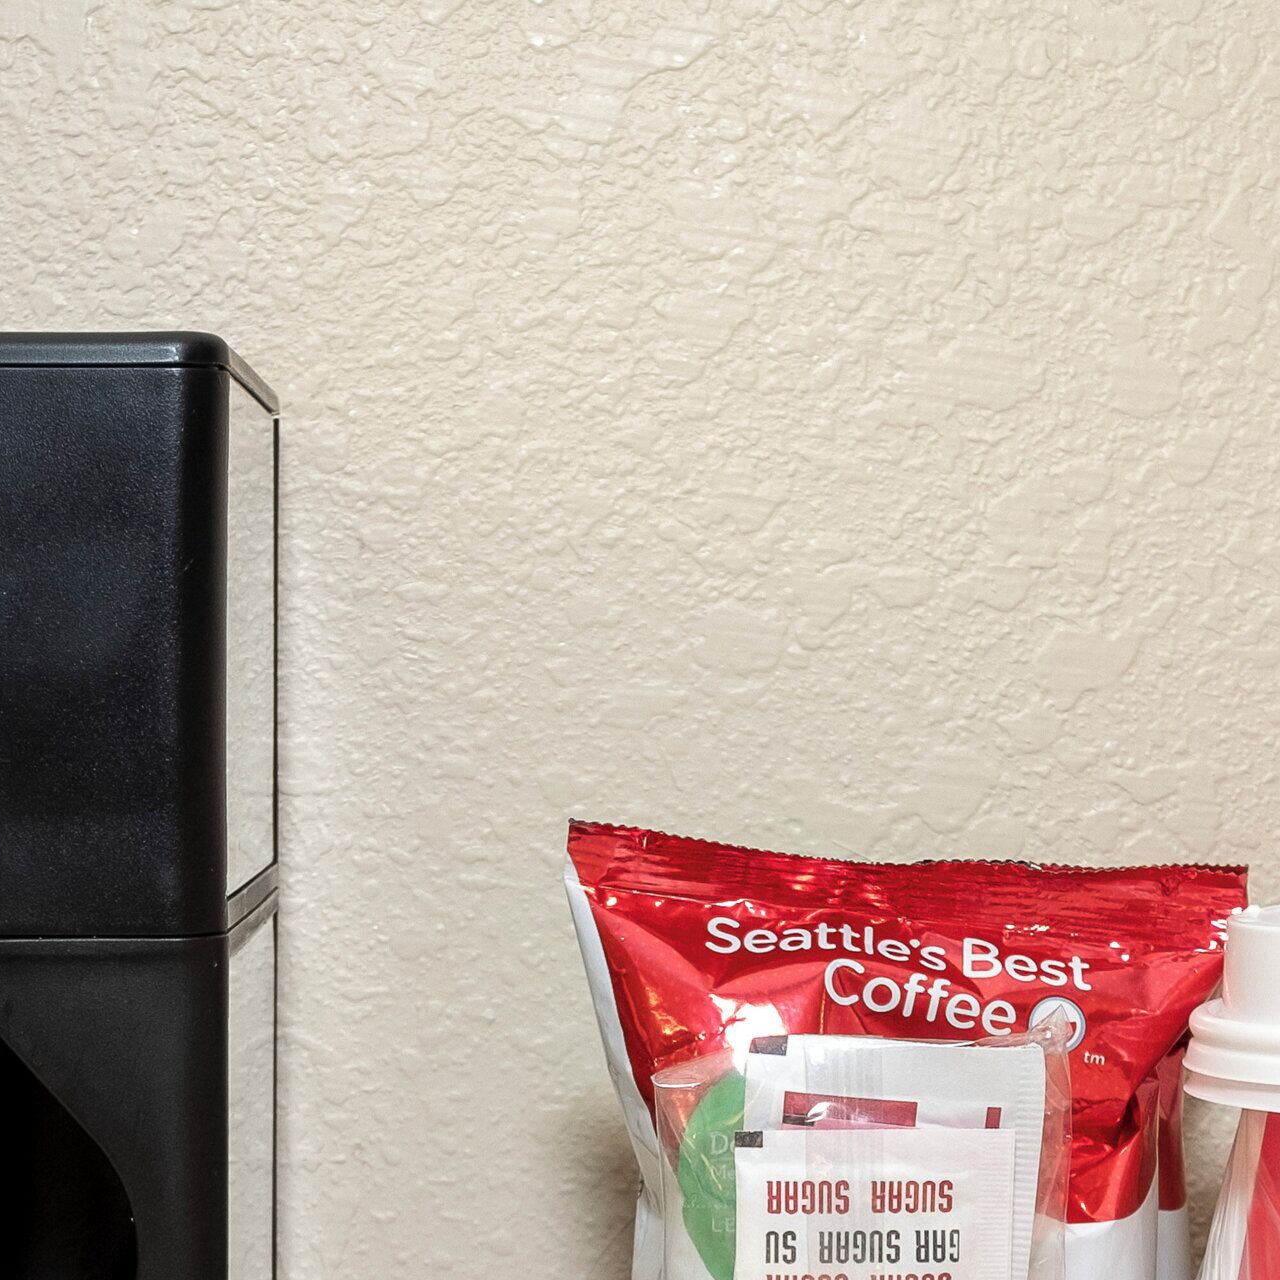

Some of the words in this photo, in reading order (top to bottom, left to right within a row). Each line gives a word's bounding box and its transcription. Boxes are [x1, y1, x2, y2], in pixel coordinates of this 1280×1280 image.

[704, 916, 948, 972] Seattle's
[961, 937, 1093, 992] Best
[823, 958, 1018, 1038] Coffee
[766, 1180, 850, 1215] SUGAR
[871, 1180, 954, 1215] SUGAR
[765, 1230, 797, 1264] SU
[818, 1229, 902, 1264] SUGAR
[915, 1229, 961, 1264] GAR
